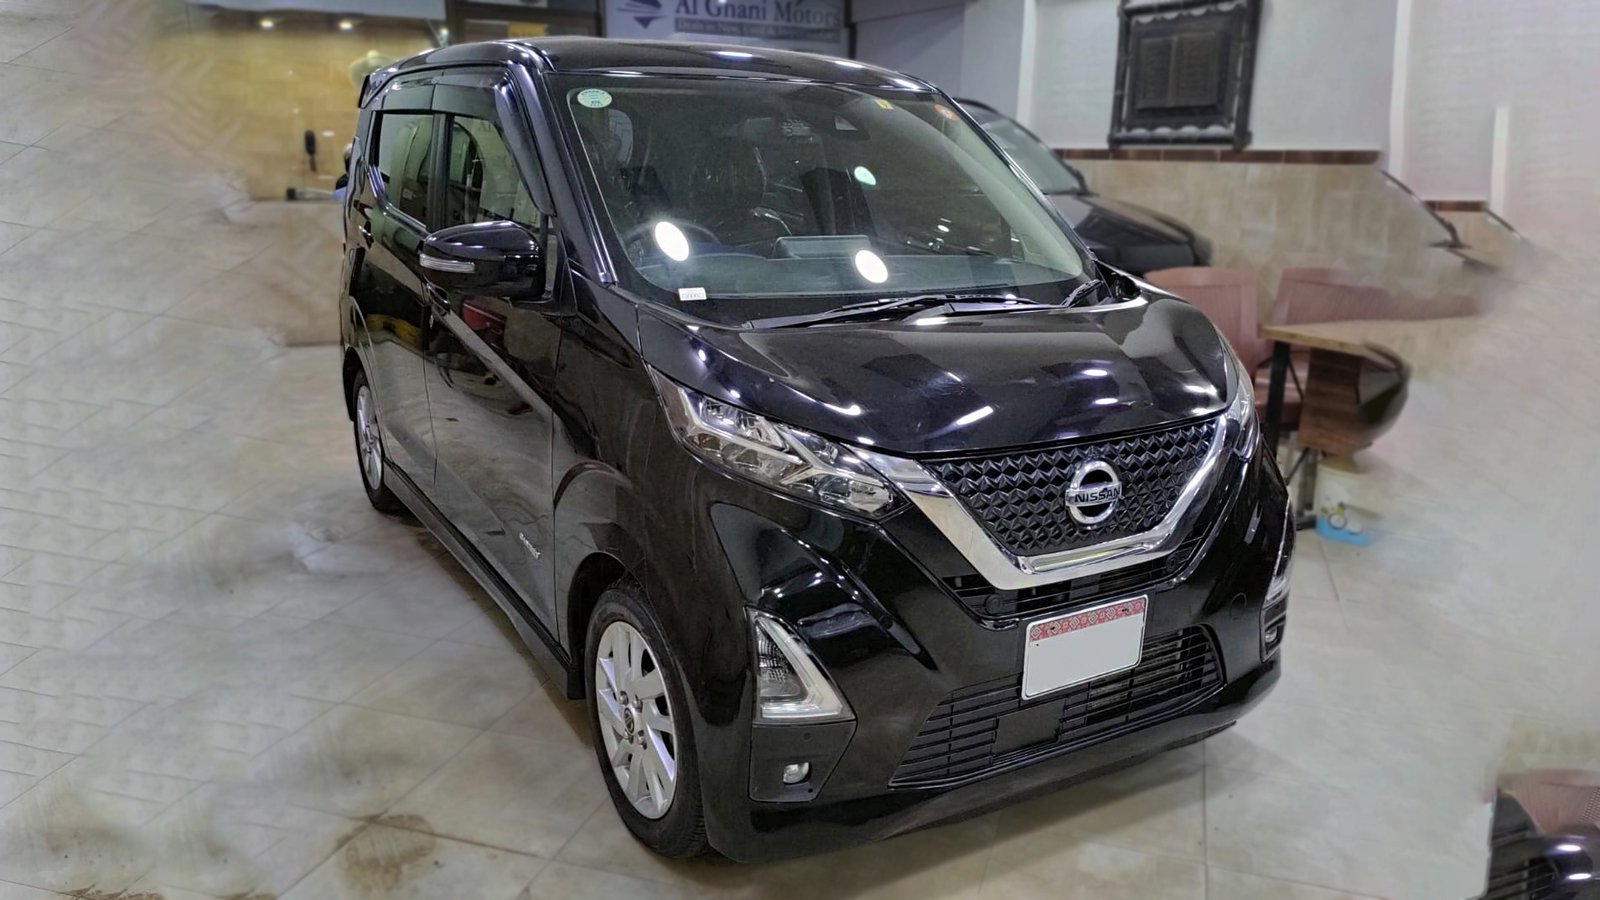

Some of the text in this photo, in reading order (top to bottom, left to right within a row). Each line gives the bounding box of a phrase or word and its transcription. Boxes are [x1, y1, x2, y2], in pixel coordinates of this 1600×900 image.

[675, 0, 698, 15] Al
[773, 0, 839, 25] Motors
[1074, 487, 1120, 503] NISSAN
